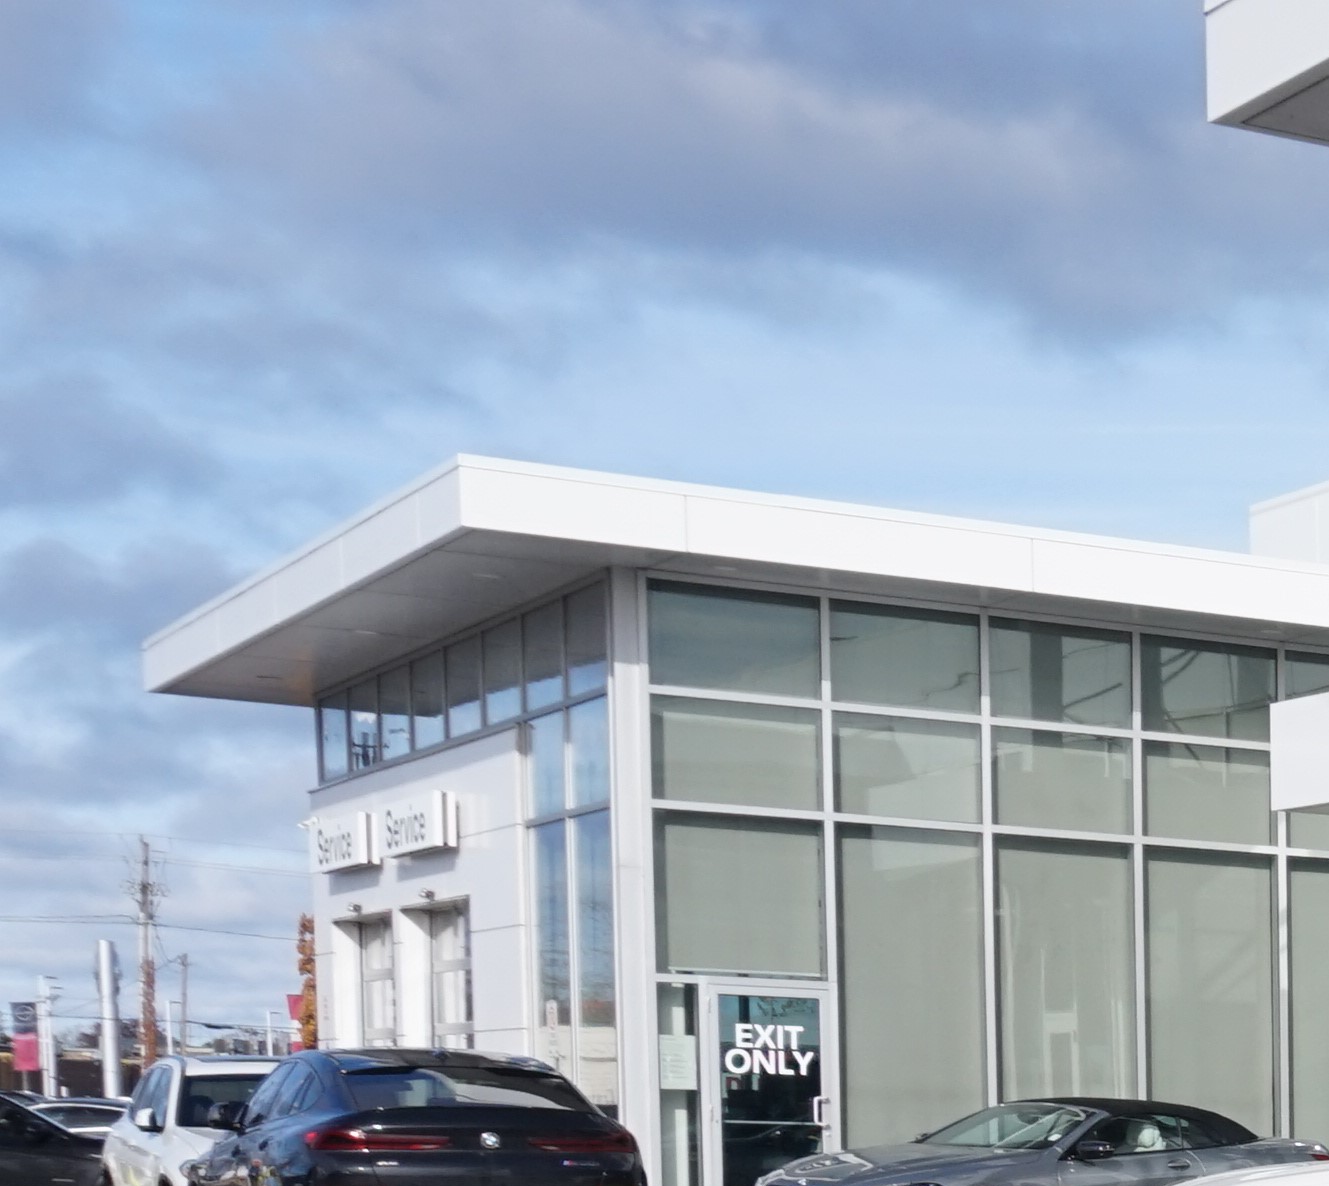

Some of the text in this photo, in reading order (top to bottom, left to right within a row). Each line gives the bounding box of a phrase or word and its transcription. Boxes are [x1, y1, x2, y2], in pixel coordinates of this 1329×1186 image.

[386, 804, 425, 849] Service
[318, 824, 352, 865] Service
[735, 1023, 805, 1050] EXIT
[725, 1048, 815, 1076] ONLY
